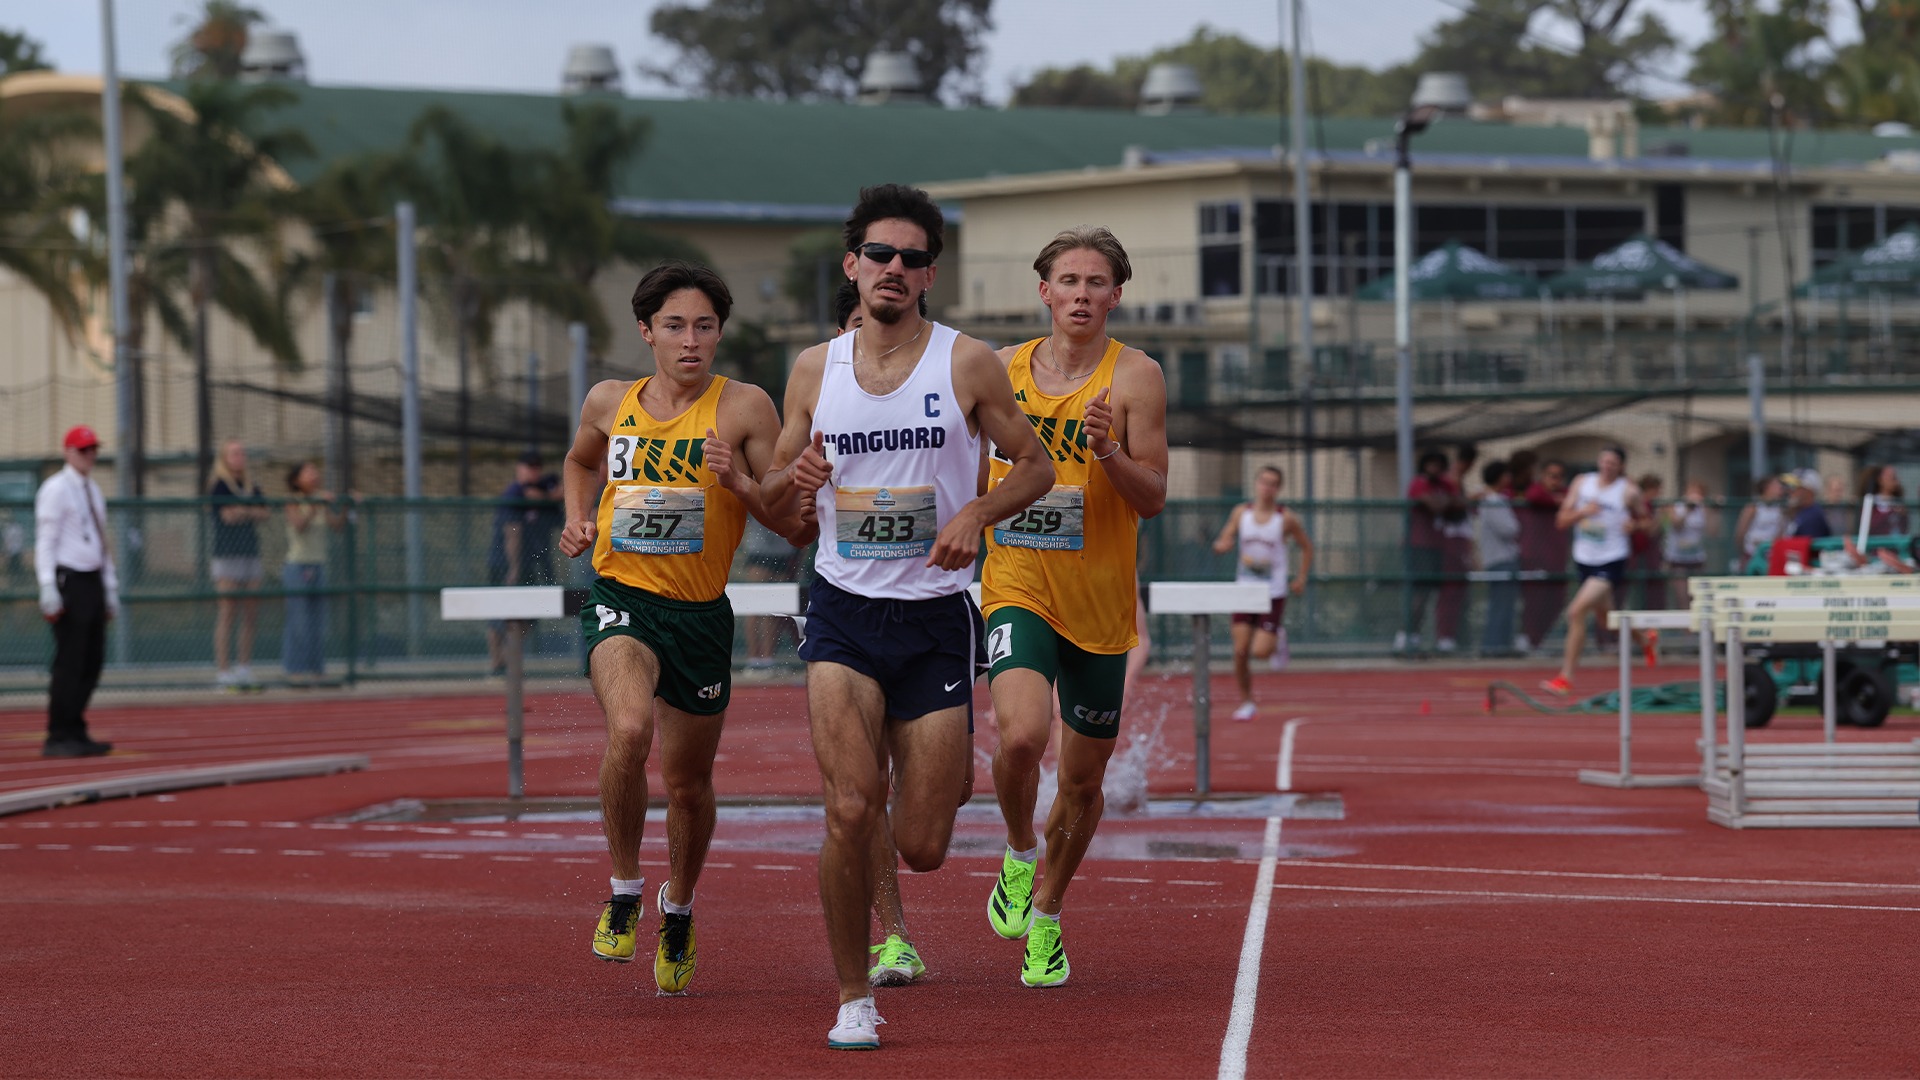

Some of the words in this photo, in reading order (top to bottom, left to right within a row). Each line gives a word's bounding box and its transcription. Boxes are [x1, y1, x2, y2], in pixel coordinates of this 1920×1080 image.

[924, 392, 941, 418] C
[612, 437, 630, 479] 3
[628, 513, 683, 538] 257
[857, 515, 915, 542] 433
[1009, 509, 1062, 534] 259
[622, 545, 690, 553] CHAMPIONSHIPS
[850, 547, 926, 558] CHAMPIONSHIPS
[1002, 537, 1071, 549] CHAMPIONSHIPS
[990, 627, 1005, 664] 2
[697, 681, 722, 700] CUI
[1073, 704, 1118, 725] CUI
